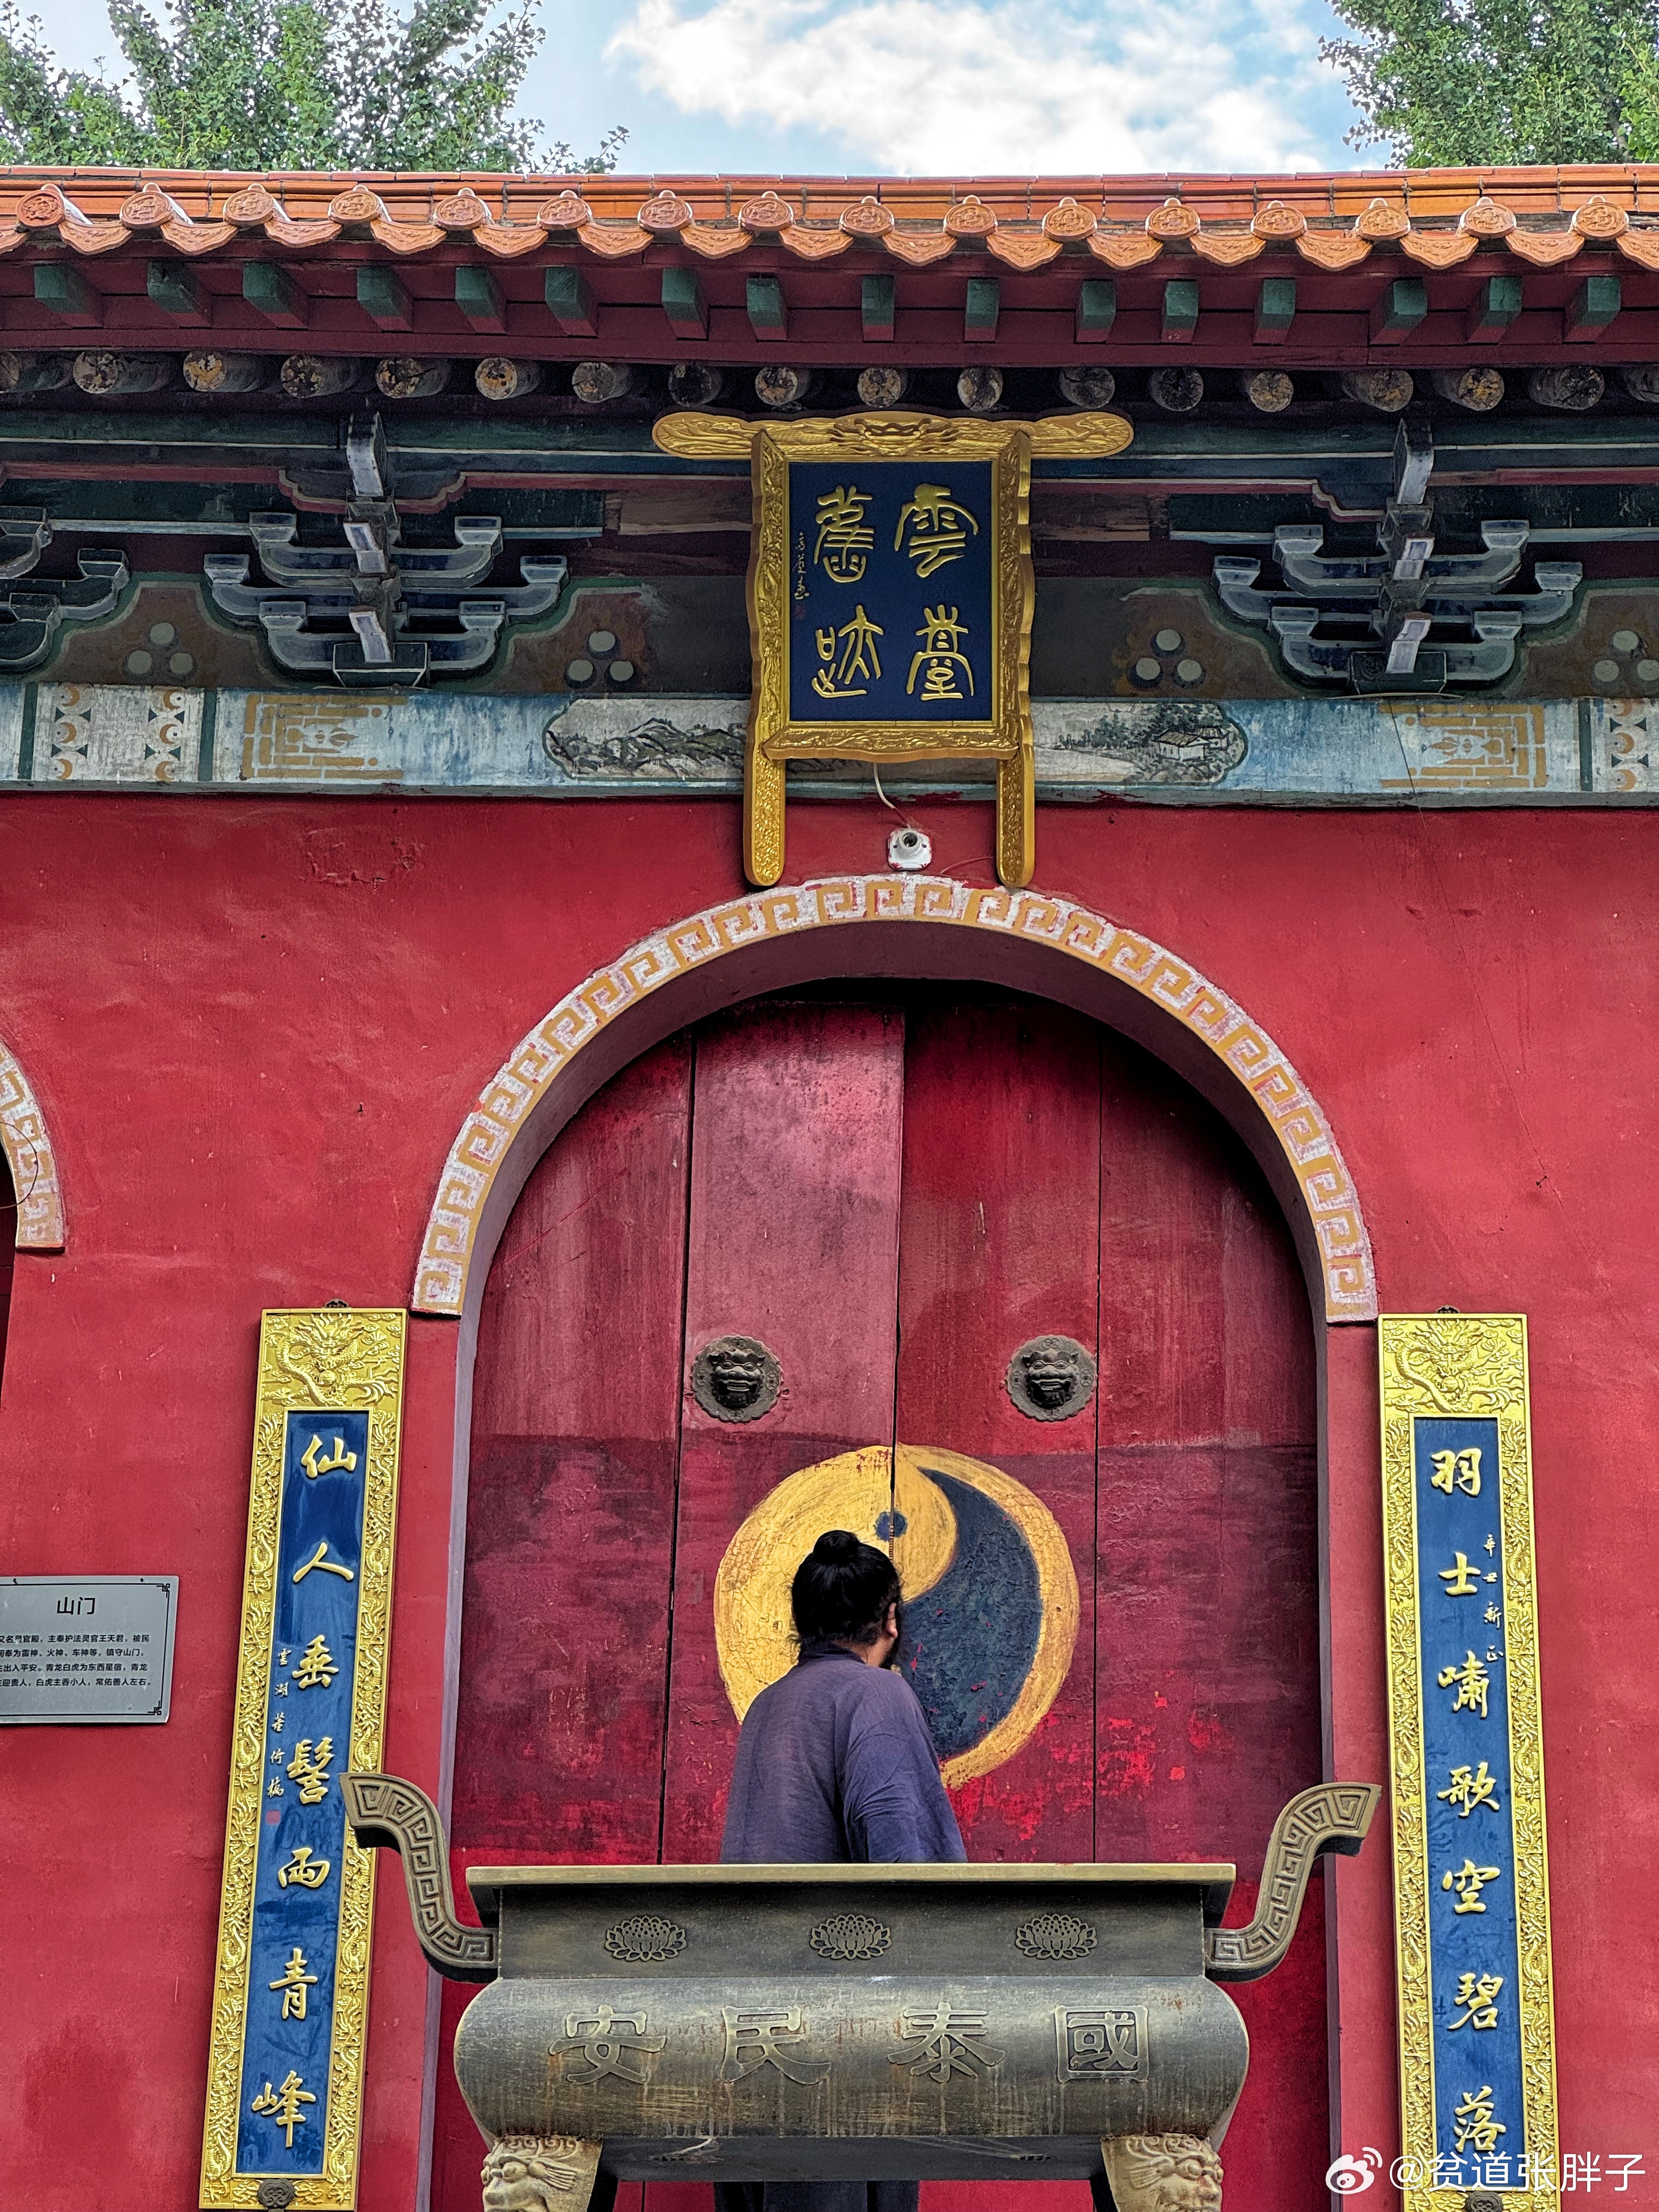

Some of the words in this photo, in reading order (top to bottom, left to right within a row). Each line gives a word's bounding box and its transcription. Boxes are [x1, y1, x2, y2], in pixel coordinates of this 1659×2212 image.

[57, 1596, 96, 1615] 山门
[0, 1678, 151, 1687] 迎贵人，白虎主吞小人，常佑善人左右。
